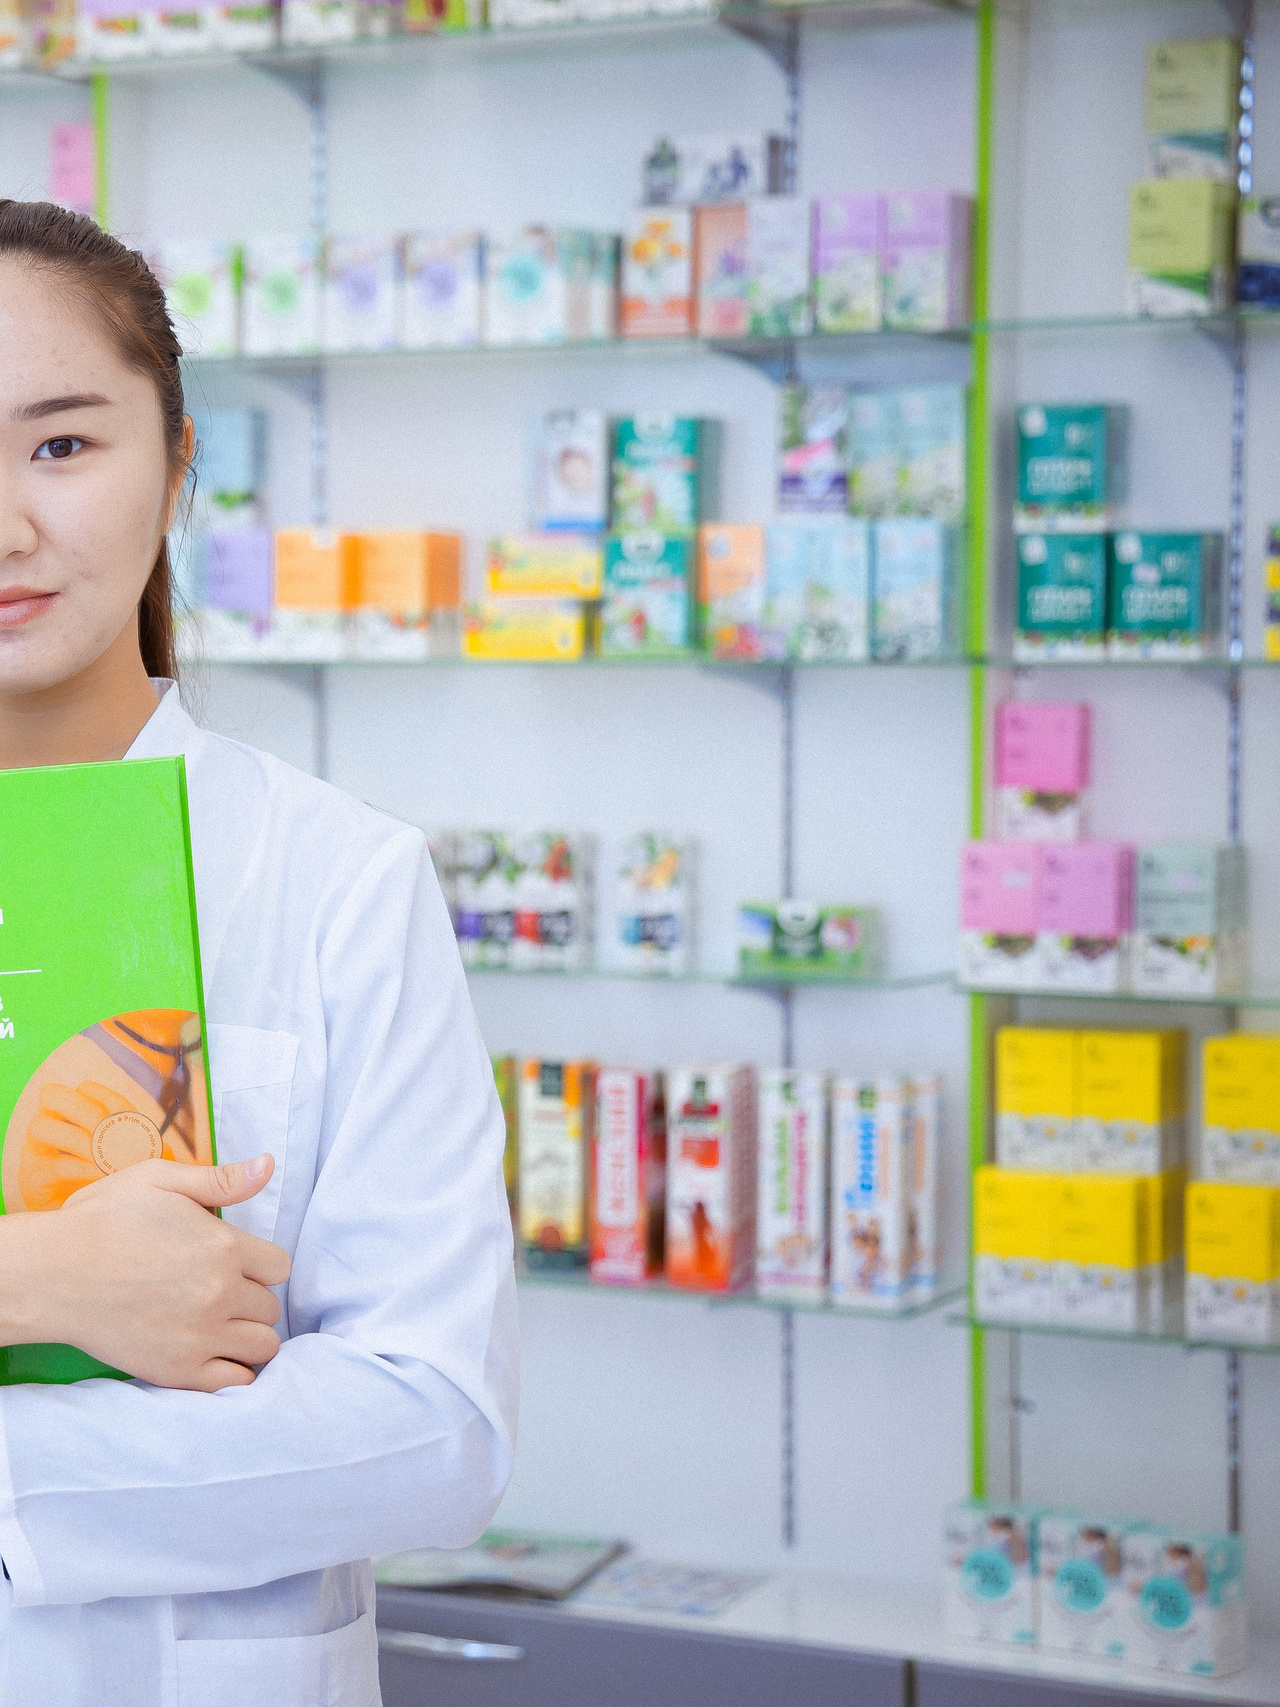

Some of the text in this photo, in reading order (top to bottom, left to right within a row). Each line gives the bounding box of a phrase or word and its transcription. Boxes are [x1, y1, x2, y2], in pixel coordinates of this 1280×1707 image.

[124, 1115, 140, 1124] Prim
[141, 1123, 151, 1133] um
[103, 1160, 112, 1169] um
